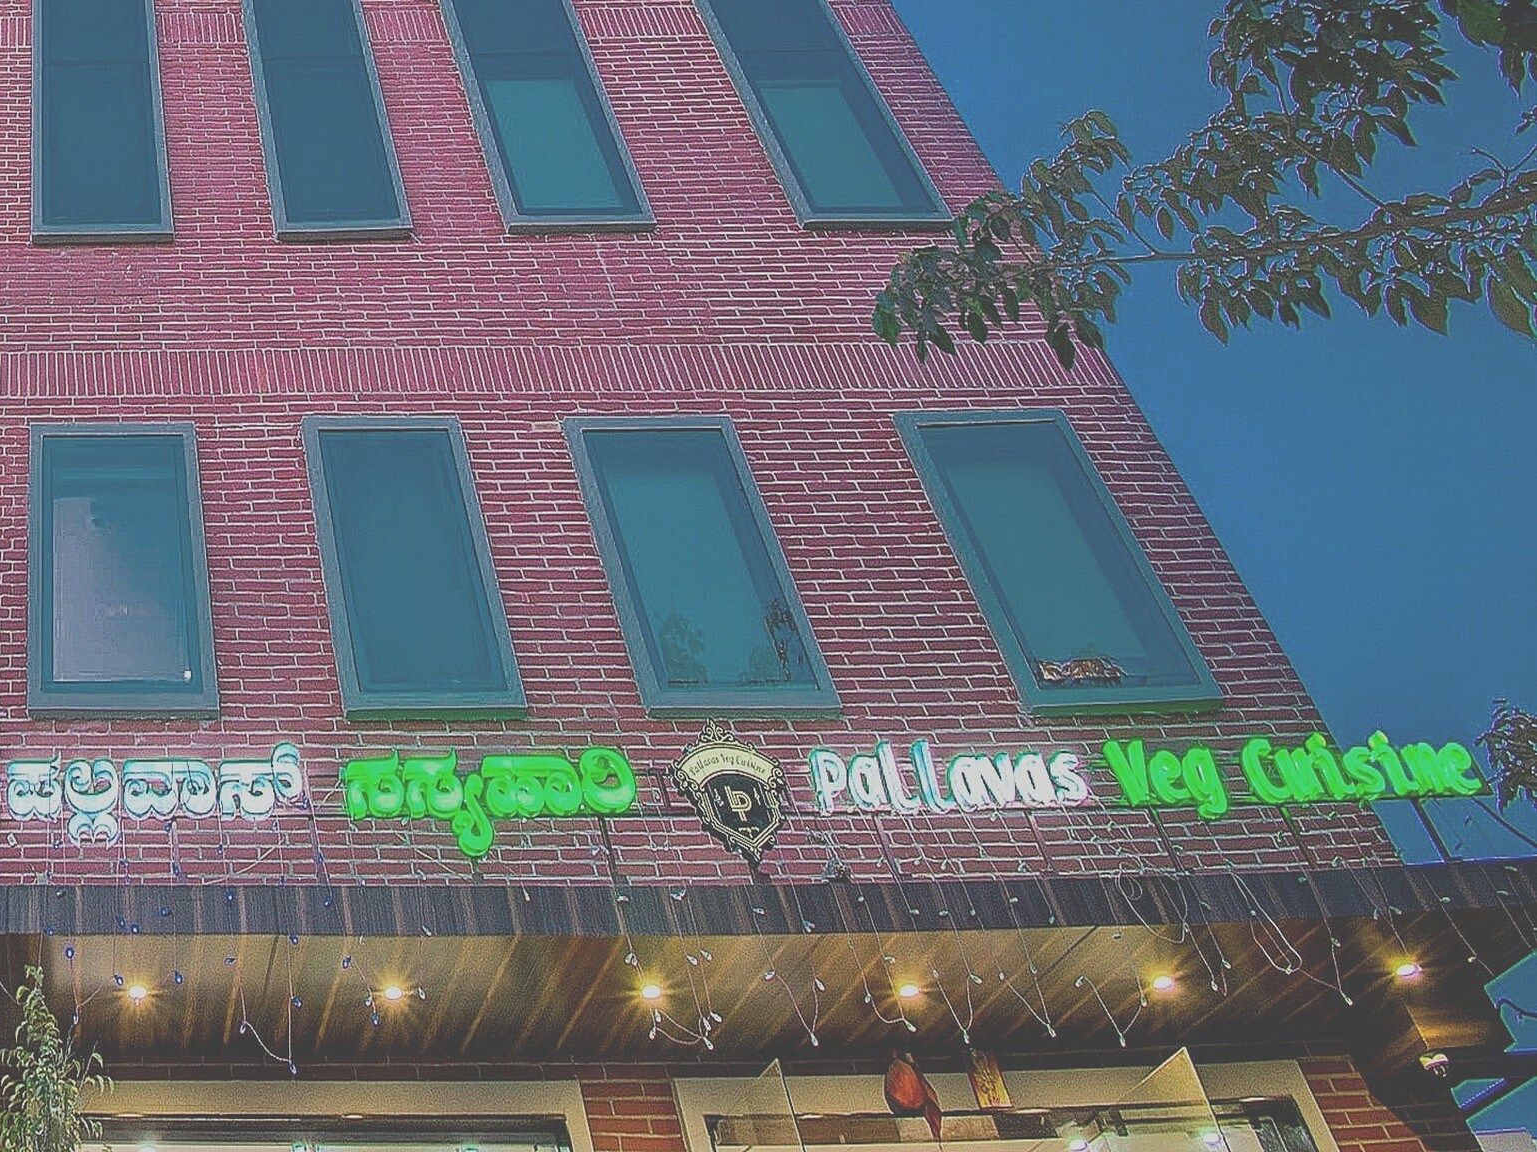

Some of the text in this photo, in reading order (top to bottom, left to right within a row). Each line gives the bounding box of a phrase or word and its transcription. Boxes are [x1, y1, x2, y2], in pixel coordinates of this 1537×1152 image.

[808, 730, 1483, 819] Pallavas Veg Cuisine
